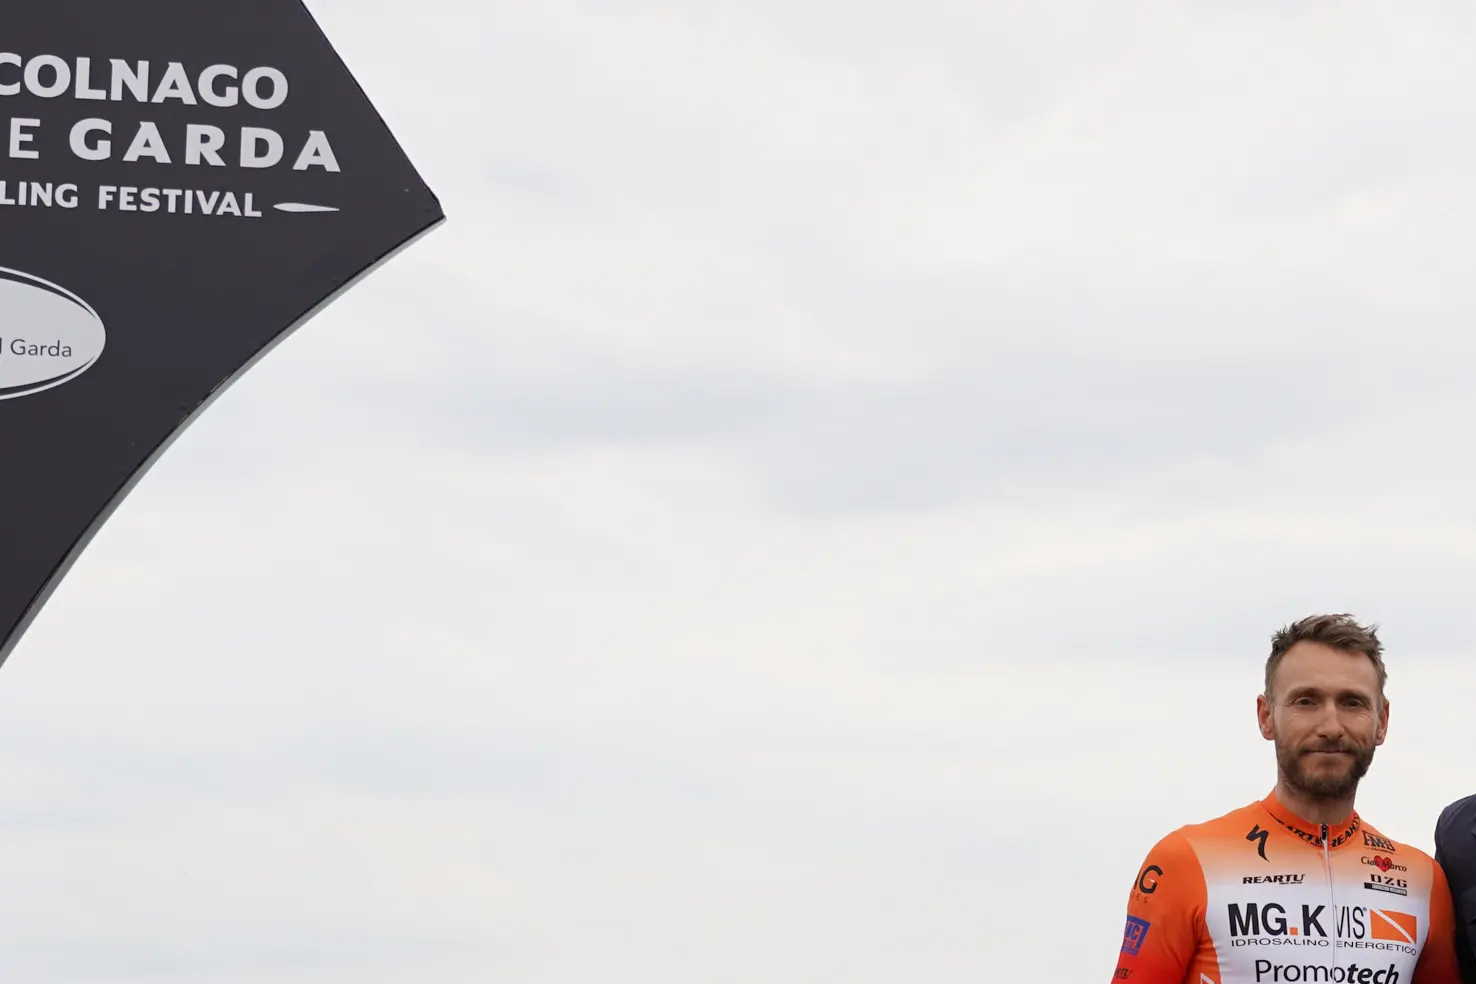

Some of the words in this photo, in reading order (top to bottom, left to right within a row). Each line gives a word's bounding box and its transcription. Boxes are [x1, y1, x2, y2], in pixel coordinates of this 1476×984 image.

[69, 117, 342, 172] GARDA
[98, 185, 262, 217] FESTIVAL
[10, 338, 72, 358] Garda
[1360, 855, 1380, 868] Ciao
[1381, 859, 1408, 873] Marco
[1231, 938, 1329, 948] IDROSALINO
[1336, 940, 1417, 956] ENERGETICO
